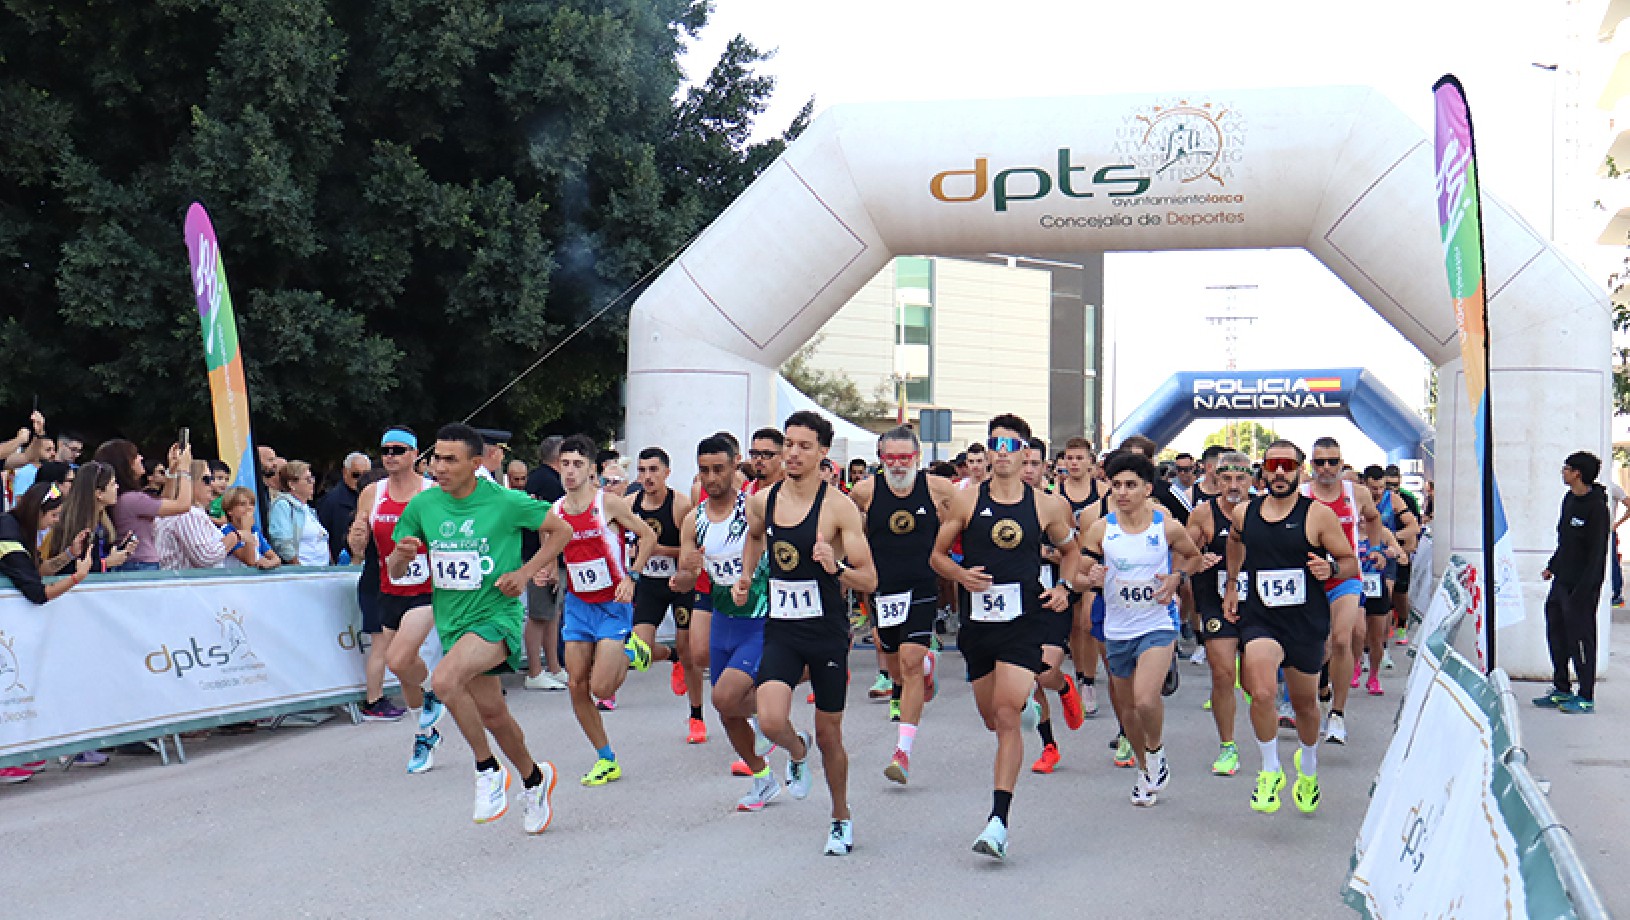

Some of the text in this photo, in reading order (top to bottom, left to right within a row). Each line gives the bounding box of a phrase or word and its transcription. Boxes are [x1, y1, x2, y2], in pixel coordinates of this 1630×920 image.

[929, 147, 1151, 212] dpts
[1136, 212, 1162, 227] de
[1165, 210, 1244, 228] Deportes
[1193, 377, 1310, 393] POLICIA
[1193, 392, 1341, 410] NACIONAL
[435, 561, 470, 580] 142
[712, 557, 743, 577] 245
[578, 569, 598, 585] 19
[1119, 586, 1154, 602] 460
[1261, 578, 1297, 597] 154
[777, 589, 812, 609] 711
[983, 593, 1006, 612] 54
[880, 601, 907, 619] 387
[144, 636, 230, 678] dpts
